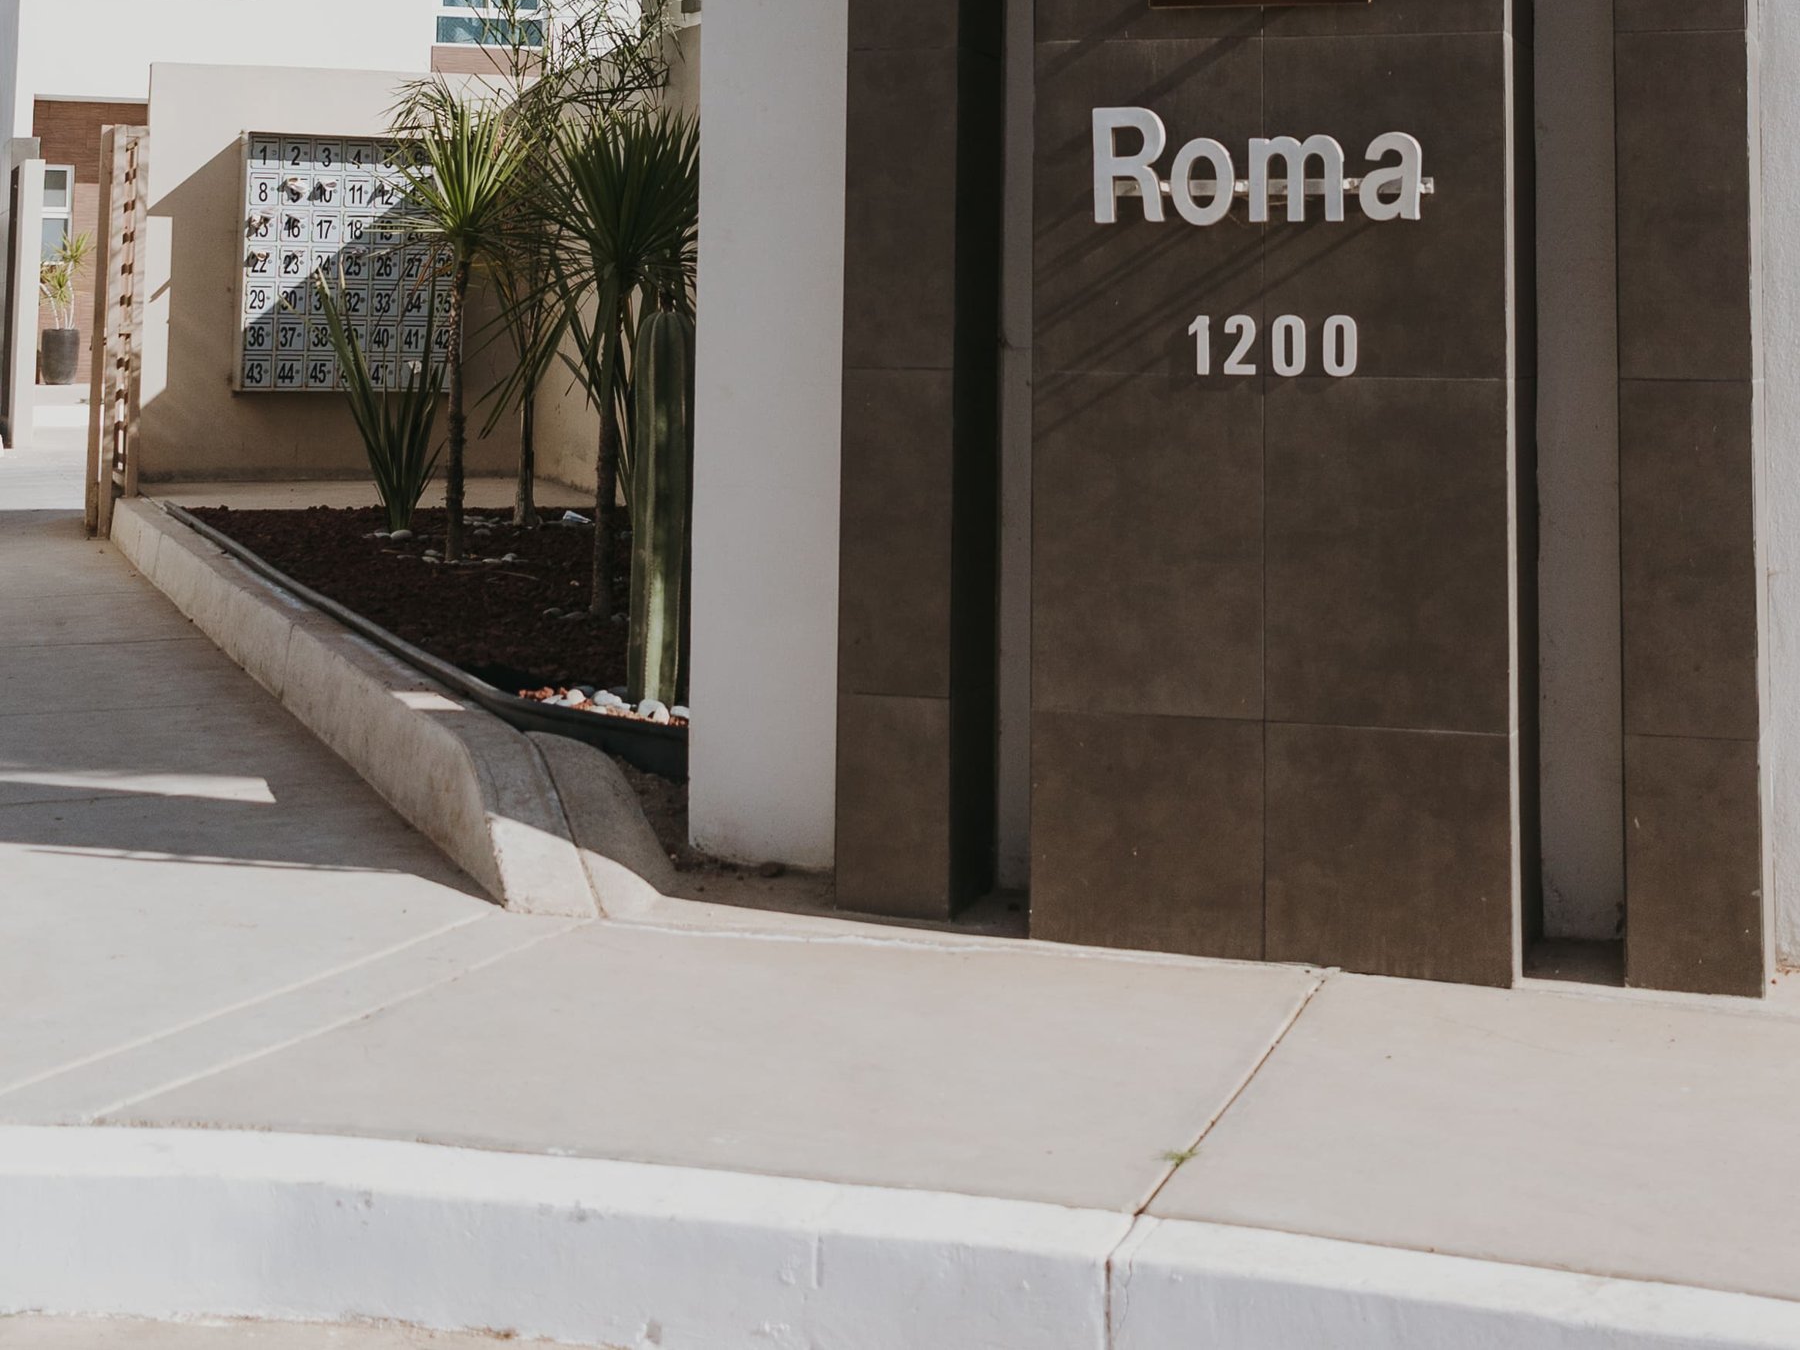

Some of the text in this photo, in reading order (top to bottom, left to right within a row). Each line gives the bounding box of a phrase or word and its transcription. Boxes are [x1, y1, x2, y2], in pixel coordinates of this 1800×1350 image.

[259, 145, 267, 165] 1
[290, 146, 300, 166] 2
[322, 147, 332, 167] 3
[351, 149, 363, 169] 4
[1092, 106, 1423, 226] Roma
[258, 182, 268, 202] 8
[348, 184, 363, 204] 11
[284, 218, 300, 238] 16
[316, 219, 333, 240] 17
[347, 220, 363, 240] 18
[283, 255, 300, 274] 23
[345, 256, 361, 276] 25
[375, 256, 392, 277] 26
[406, 257, 423, 278] 27
[249, 290, 265, 310] 29
[281, 290, 297, 310] 30
[345, 292, 360, 312] 32
[375, 293, 391, 313] 33
[248, 326, 265, 347] 36
[279, 326, 297, 347] 37
[312, 327, 329, 347] 38
[373, 328, 389, 349] 40
[404, 329, 420, 349] 41
[1188, 314, 1358, 378] 1200
[246, 363, 263, 383] 43
[277, 363, 295, 383] 44
[309, 363, 327, 383] 45
